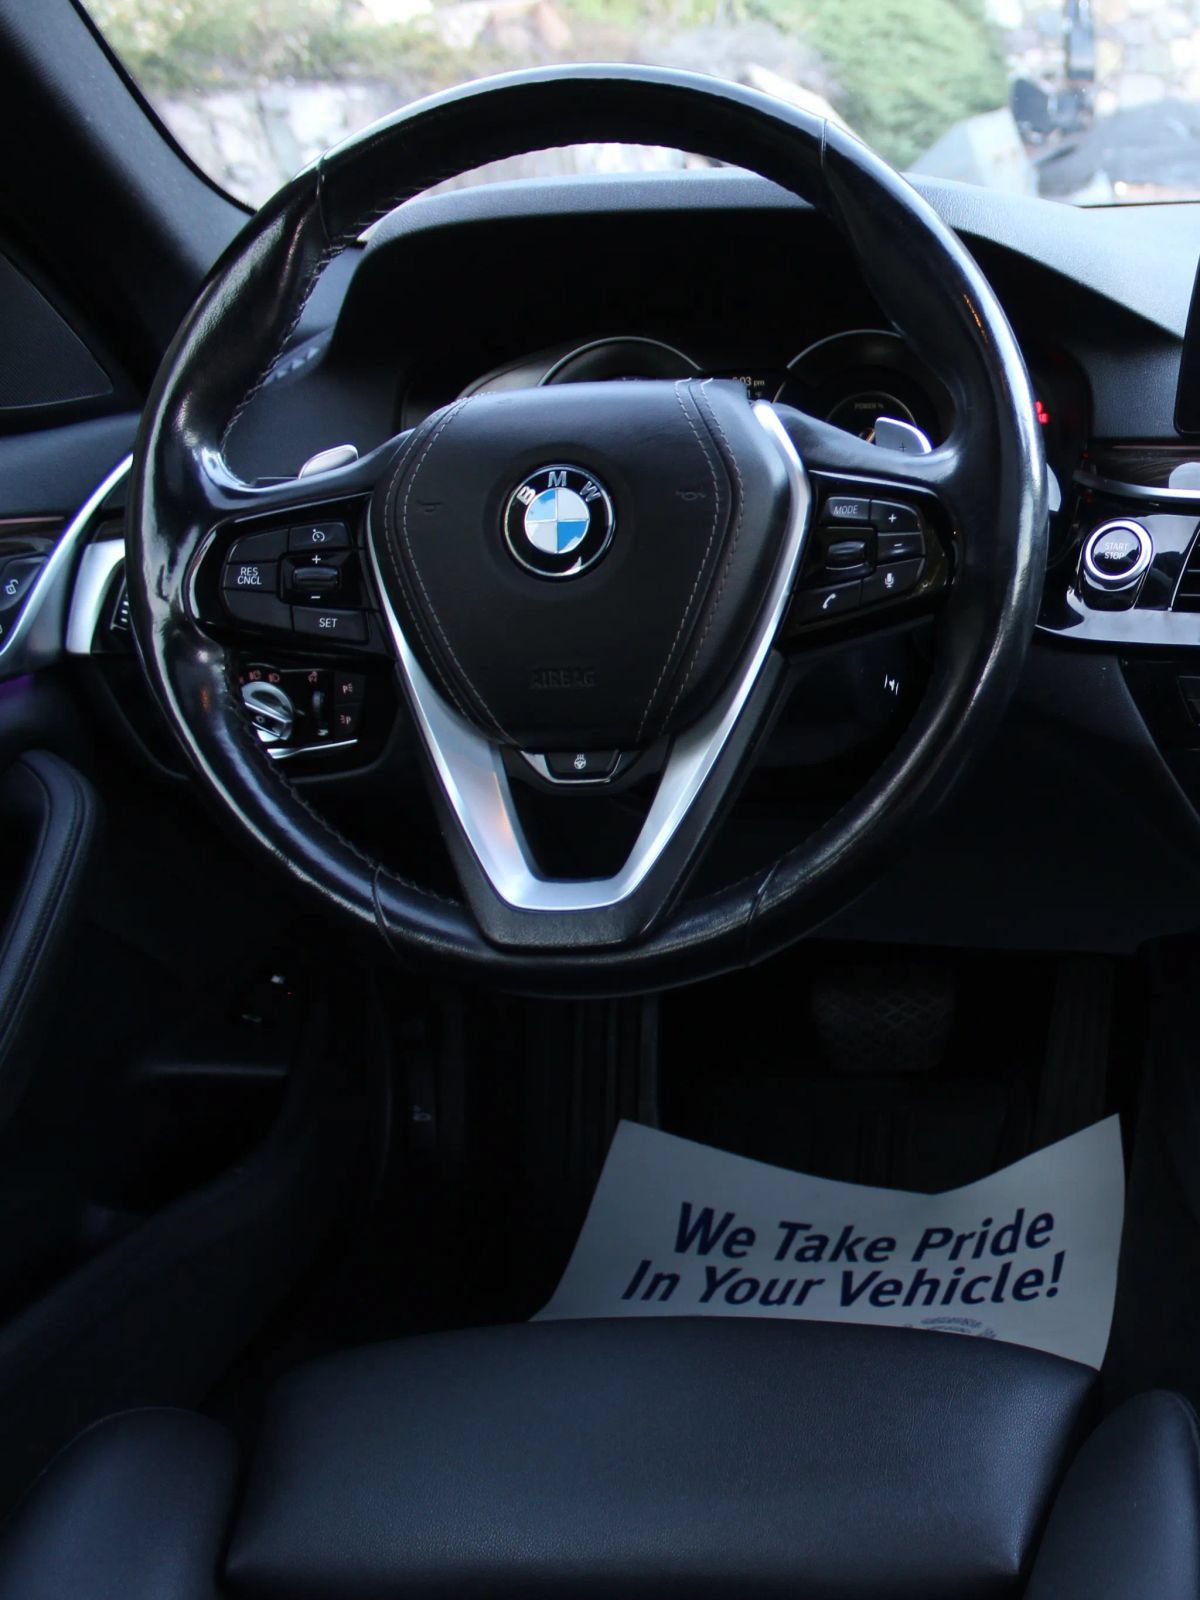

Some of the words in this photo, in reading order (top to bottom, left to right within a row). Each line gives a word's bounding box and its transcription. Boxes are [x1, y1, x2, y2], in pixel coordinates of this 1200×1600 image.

[516, 471, 601, 506] BMW
[833, 505, 859, 515] MODE
[1104, 542, 1129, 551] START
[1104, 551, 1125, 559] STOP
[240, 567, 259, 576] RES
[237, 575, 263, 585] CNCL
[319, 618, 338, 628] SET
[673, 1201, 756, 1260] We
[773, 1220, 897, 1264] Take
[911, 1207, 1055, 1264] Pride
[620, 1258, 681, 1301] In
[698, 1265, 827, 1308] Your
[838, 1250, 1067, 1308] Vehicle!
